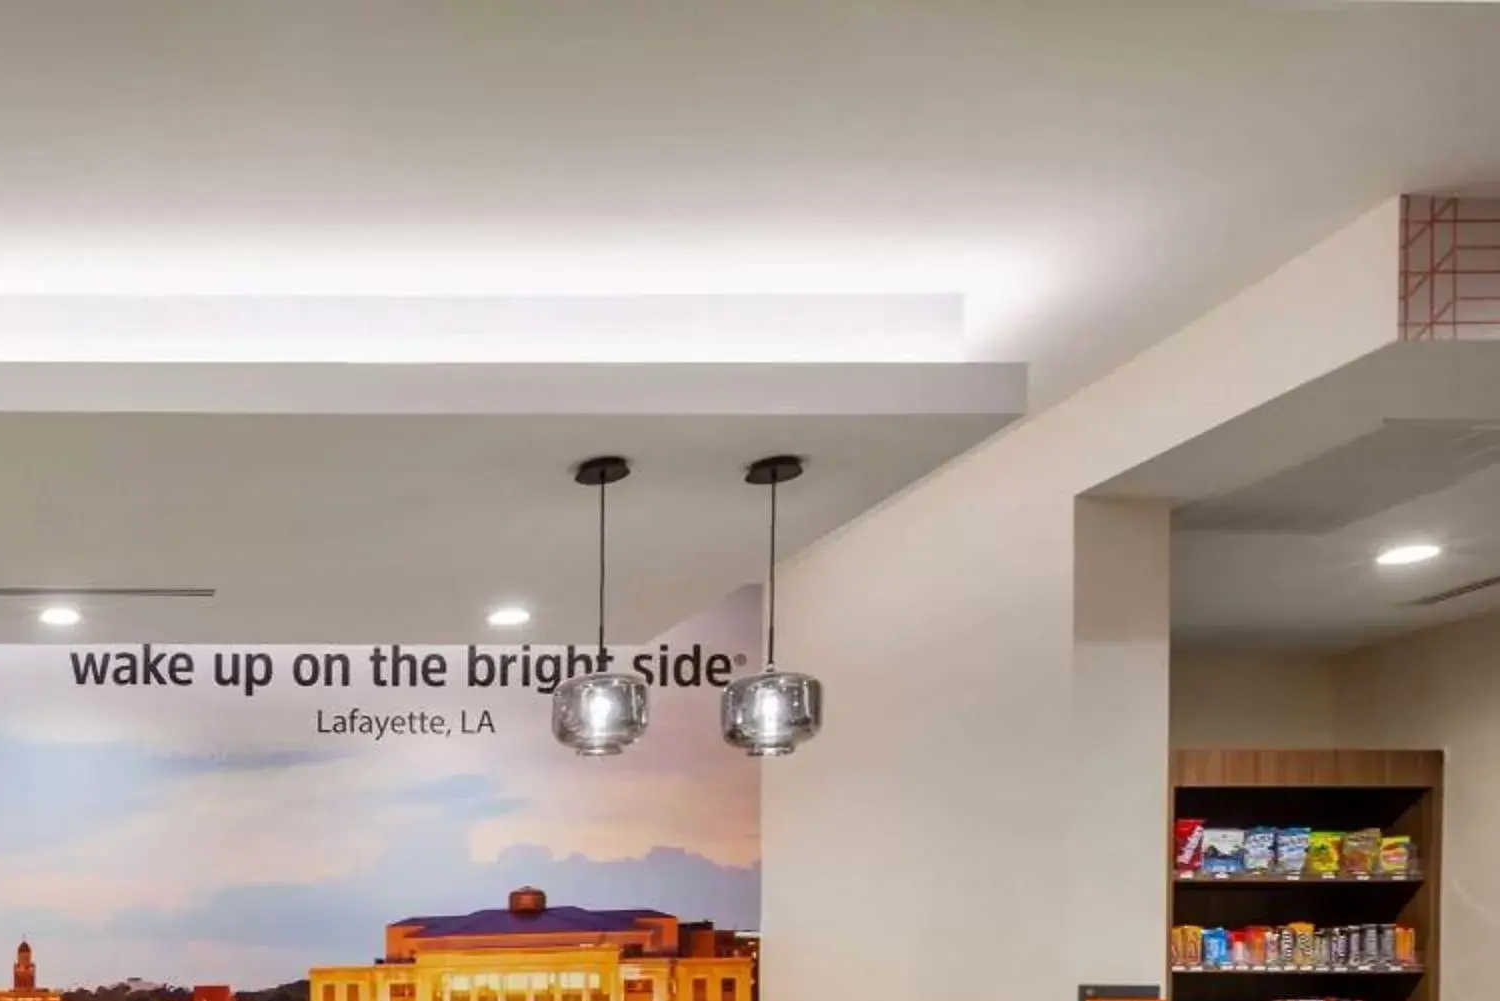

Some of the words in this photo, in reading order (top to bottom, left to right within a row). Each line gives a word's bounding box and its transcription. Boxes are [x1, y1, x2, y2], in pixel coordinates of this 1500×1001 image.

[70, 643, 194, 686] wake
[214, 651, 273, 697] up
[292, 651, 350, 687] on
[368, 644, 447, 687] the
[467, 644, 615, 694] bright
[317, 708, 452, 739] Lafayette,
[460, 709, 496, 735] LA
